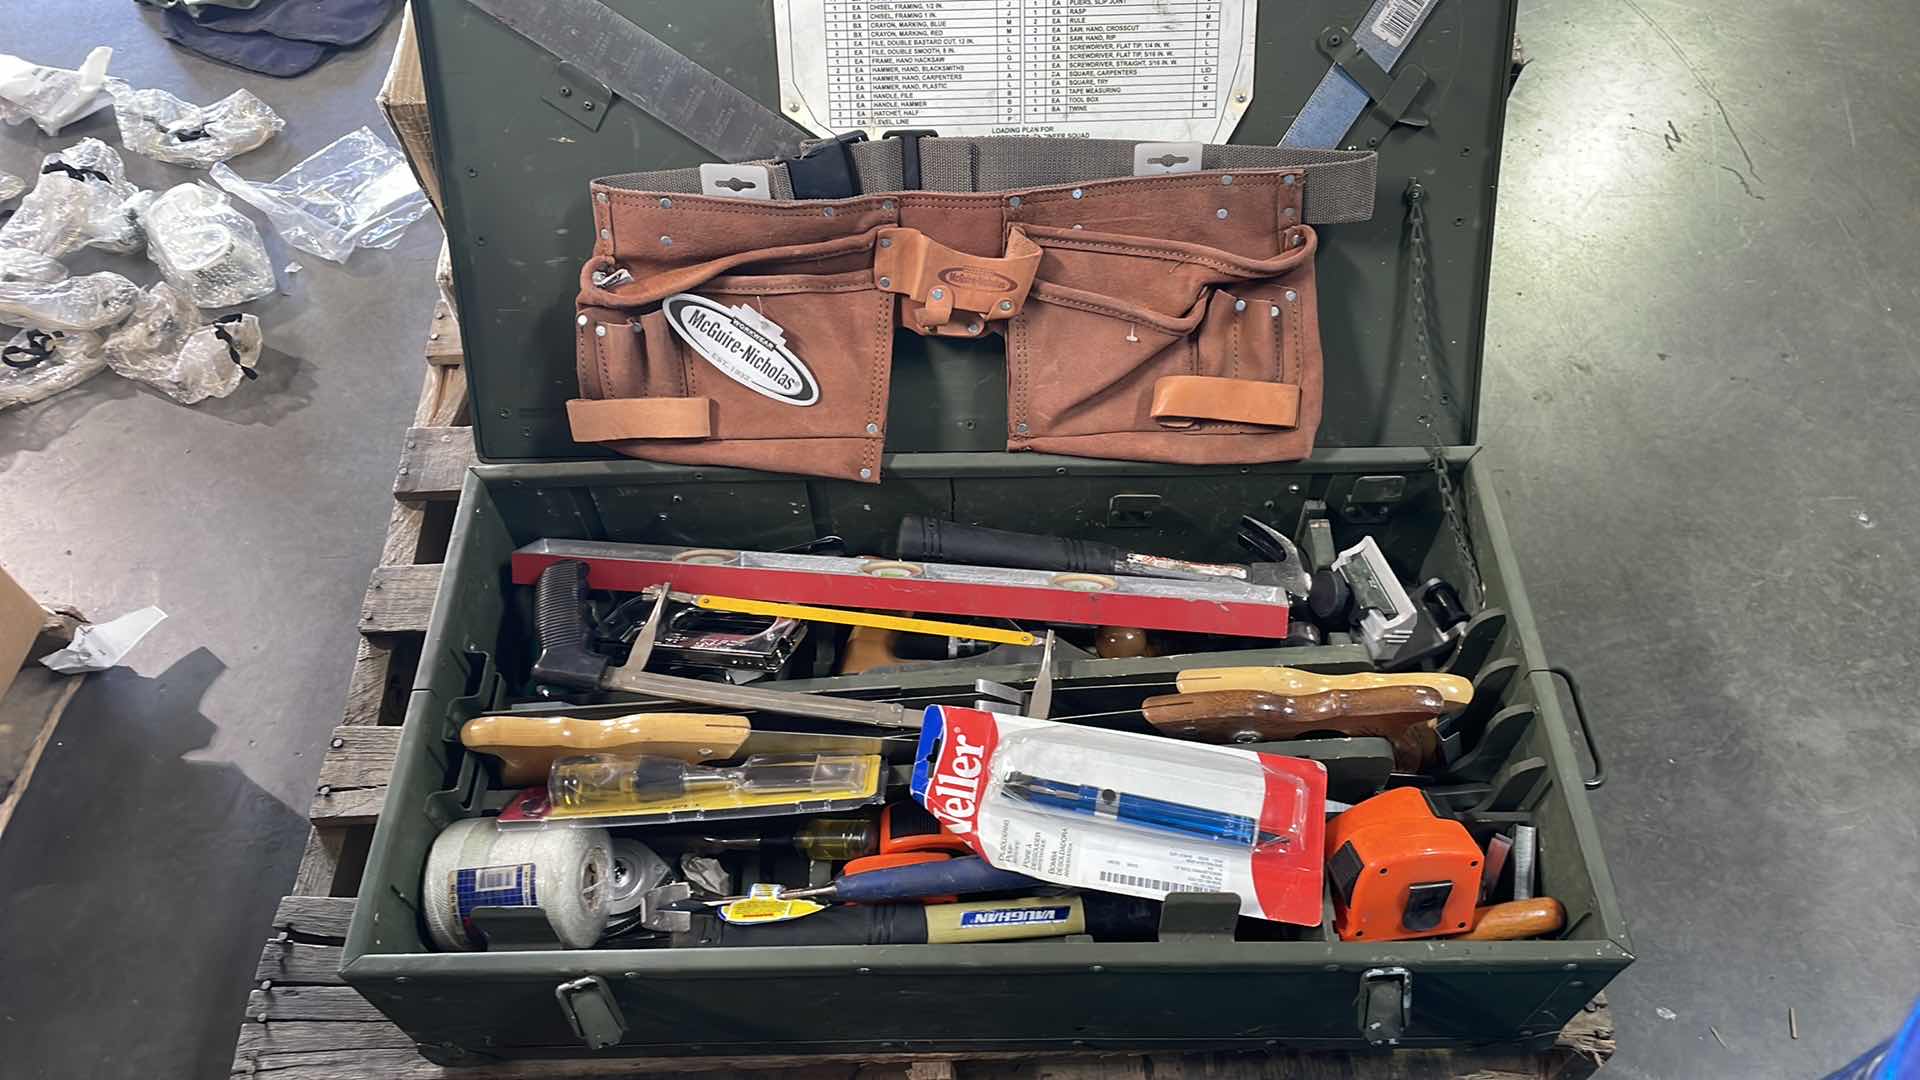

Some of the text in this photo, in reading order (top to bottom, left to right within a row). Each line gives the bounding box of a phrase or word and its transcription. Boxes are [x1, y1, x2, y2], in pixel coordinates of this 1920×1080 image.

[1096, 68, 1137, 76] CARPENTERS
[1085, 86, 1121, 94] MEASURING
[991, 127, 1020, 135] LOADING
[1022, 126, 1039, 134] PLAN
[975, 909, 1056, 924] VAUGHAN
